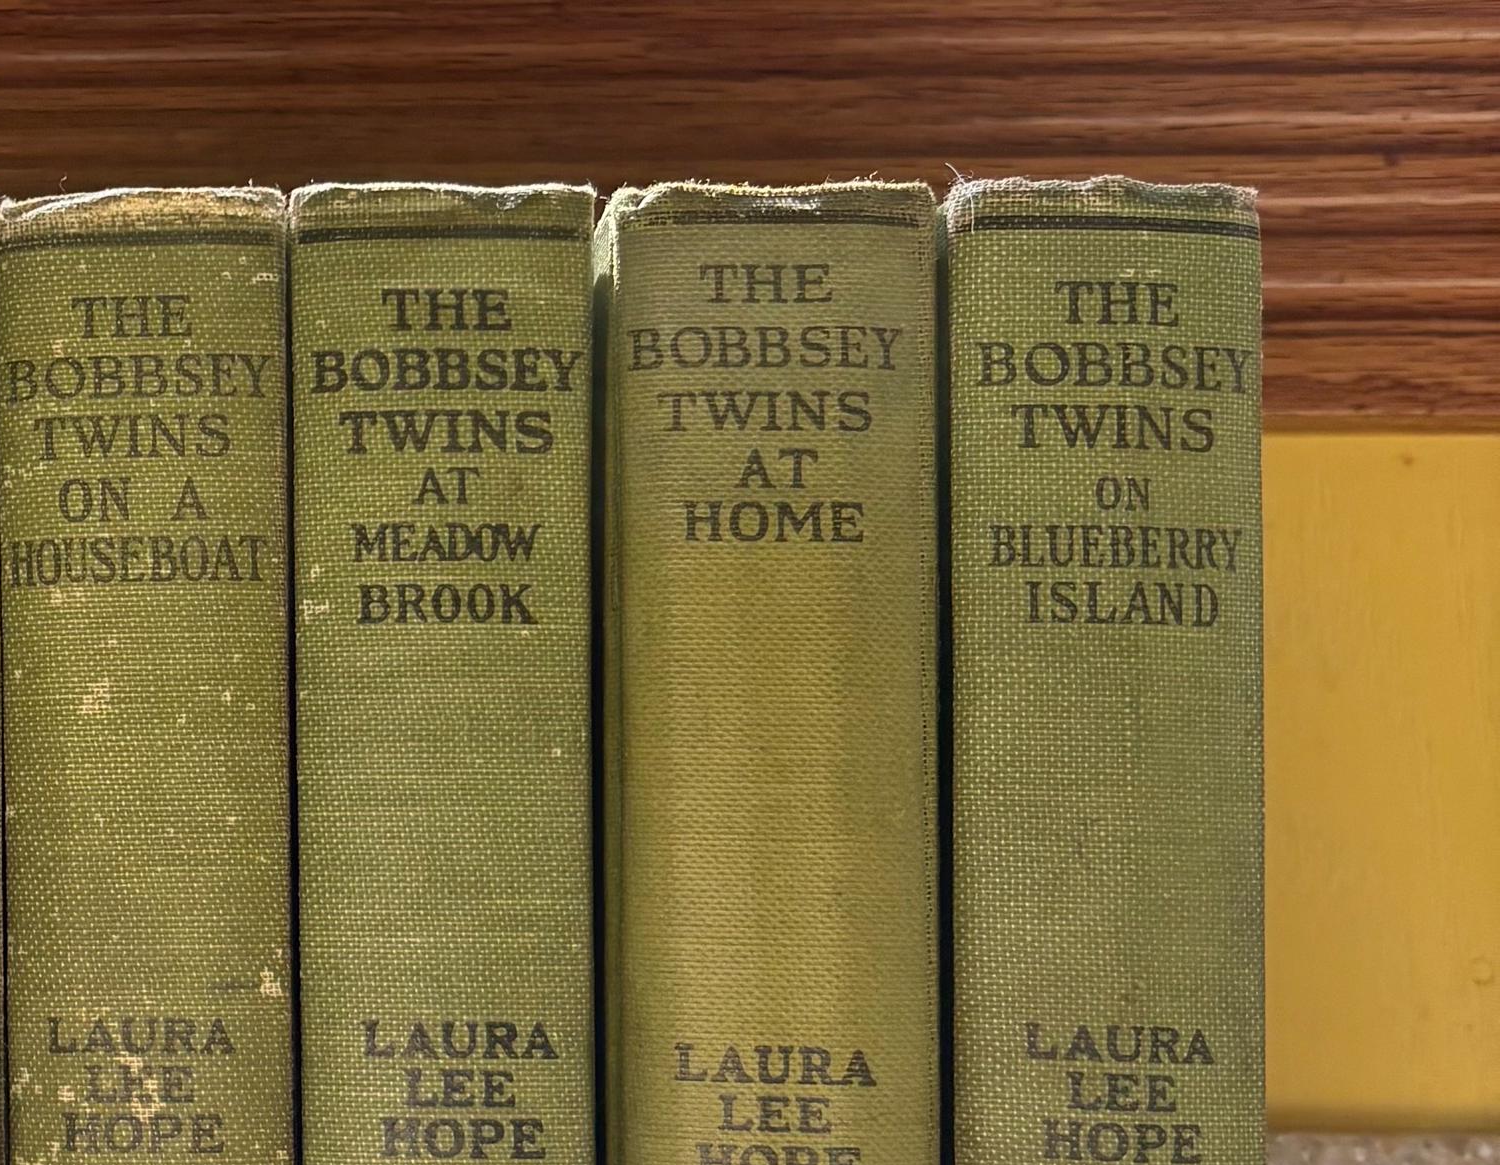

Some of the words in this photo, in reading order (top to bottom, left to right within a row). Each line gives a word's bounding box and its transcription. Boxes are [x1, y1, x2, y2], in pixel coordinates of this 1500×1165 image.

[701, 263, 832, 303] THE
[1055, 280, 1179, 327] THE
[72, 295, 192, 338] THE
[382, 288, 511, 331] THE
[627, 326, 902, 371] BOBBSEY
[976, 342, 1253, 394] BOBBSEY
[6, 354, 273, 402] BOBBSEY
[311, 348, 583, 393] BOBBSEY
[339, 410, 554, 454] TWINS
[657, 390, 872, 431] TWINS
[1011, 404, 1215, 453] TWINS
[34, 413, 230, 460] TWINS
[413, 467, 480, 504] AT
[735, 448, 818, 489] AT
[59, 478, 130, 522] ON
[172, 477, 210, 521] A
[1094, 476, 1151, 512] ON
[352, 523, 541, 562] MEADOW
[684, 501, 865, 543] HOME
[10, 535, 268, 587] HOUSEBOAT
[989, 523, 1243, 572] BLUEBERRY
[357, 583, 538, 624] BROOK
[1027, 581, 1219, 628] ISLAND
[48, 1017, 235, 1055] LAURA
[362, 1019, 560, 1060] LAURA
[1025, 1022, 1215, 1065] LAURA
[674, 1043, 877, 1087] LAURA
[401, 1068, 517, 1108] LEE
[1066, 1072, 1177, 1113] LEE
[61, 1114, 224, 1154] HOPE
[717, 1094, 832, 1134] LEE
[379, 1118, 547, 1160] HOPE
[1042, 1119, 1201, 1164] HOPE
